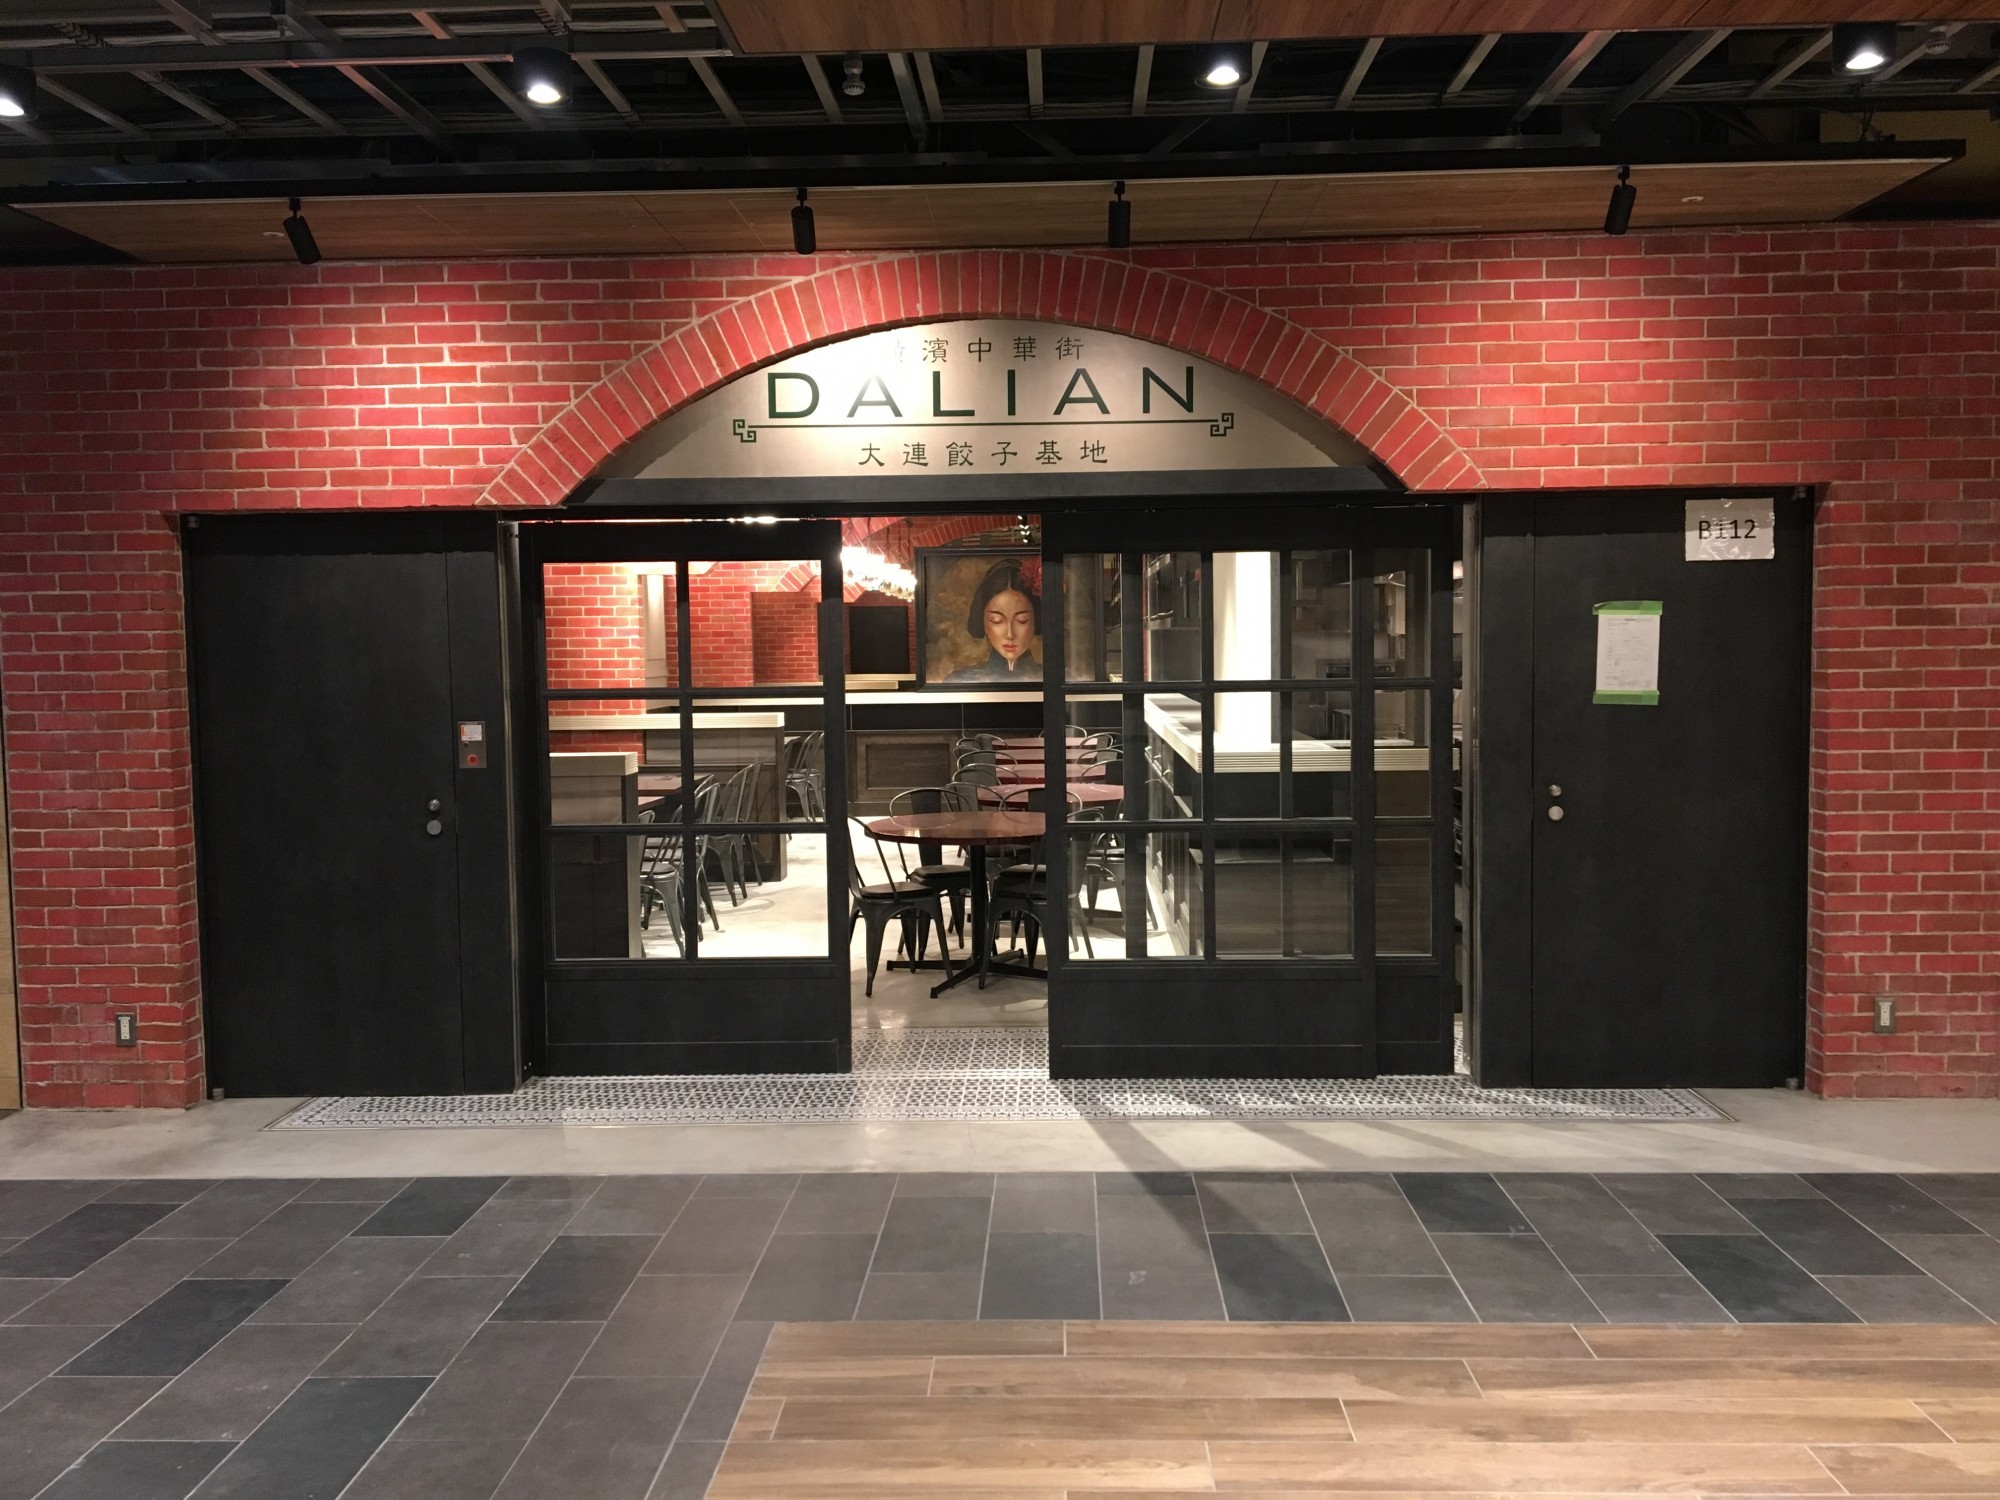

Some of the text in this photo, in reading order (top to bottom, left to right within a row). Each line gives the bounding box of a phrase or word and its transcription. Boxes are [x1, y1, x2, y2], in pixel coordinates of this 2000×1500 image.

[768, 365, 1195, 419] DALIAN
[857, 440, 1109, 467] 大連餃子基地
[1698, 519, 1758, 540] B112
